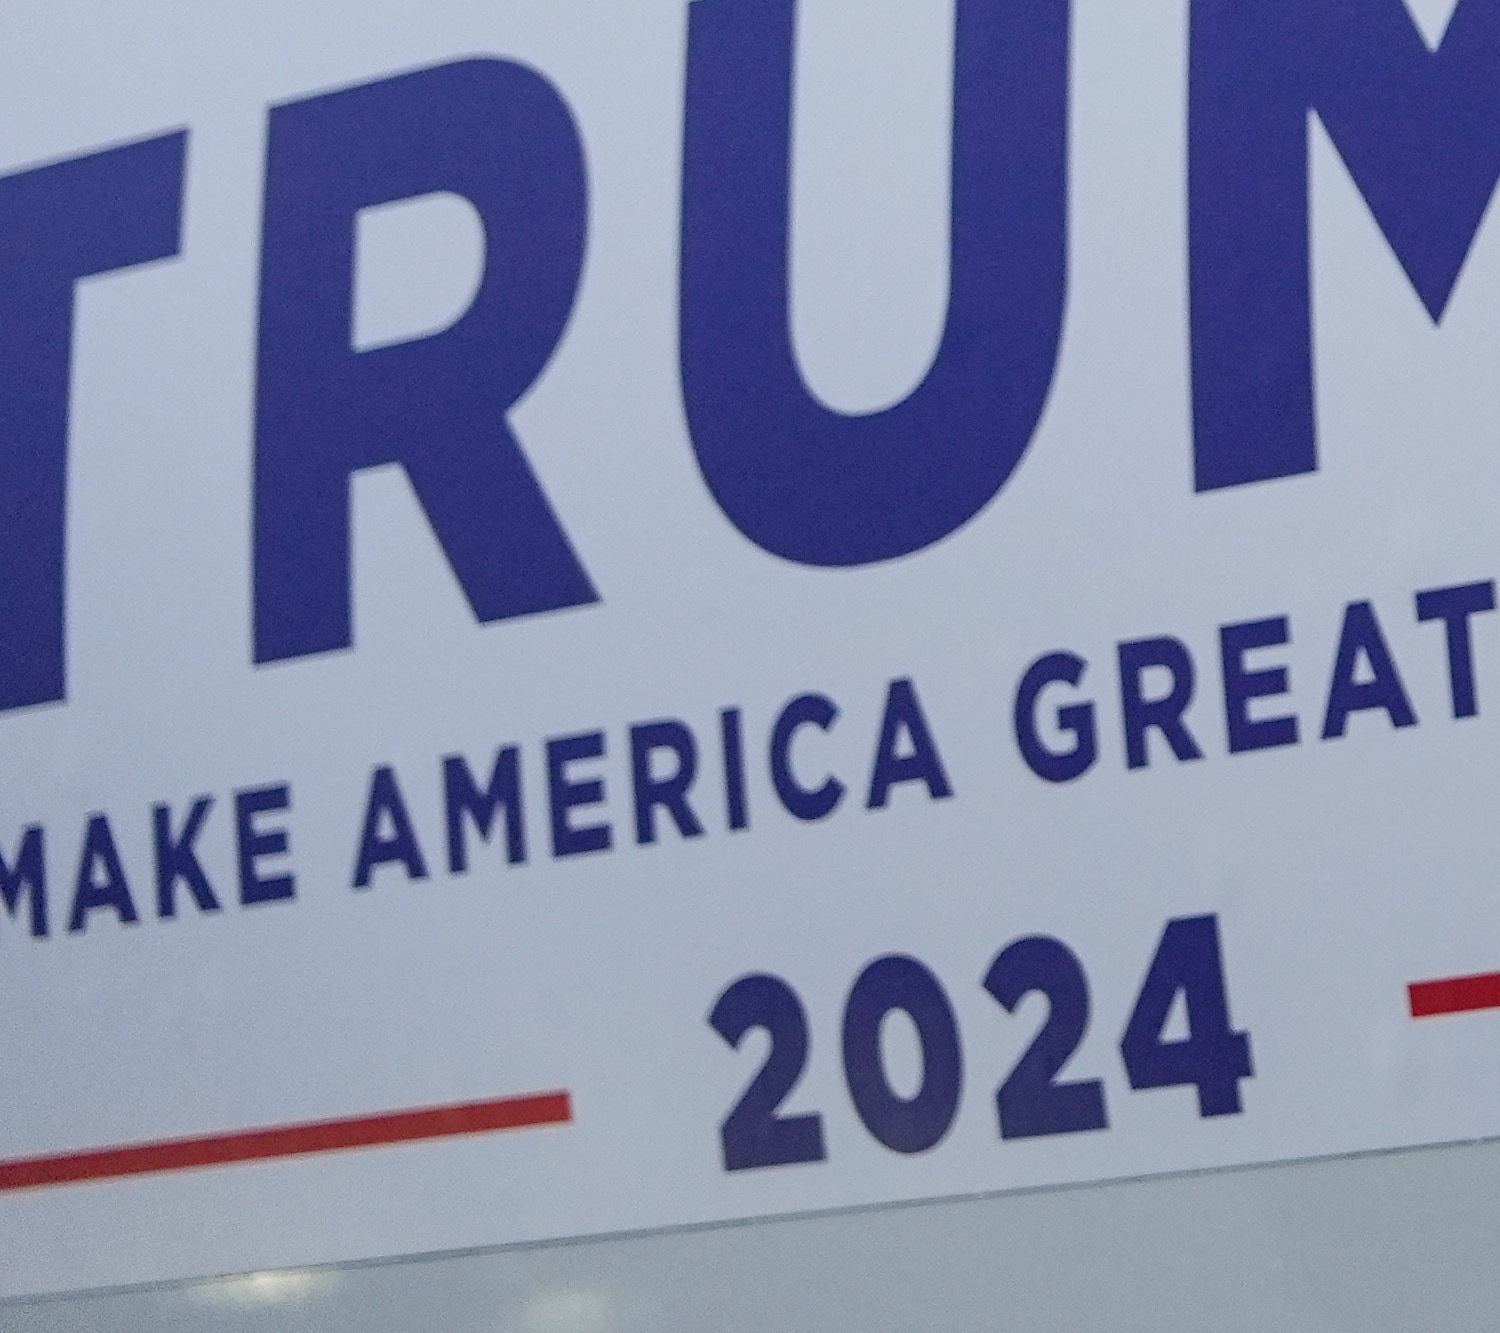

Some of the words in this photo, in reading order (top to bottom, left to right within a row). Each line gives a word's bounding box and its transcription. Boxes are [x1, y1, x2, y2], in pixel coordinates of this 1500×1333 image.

[350, 675, 955, 891] AMERICA
[1012, 578, 1499, 783] GREAT
[706, 911, 1255, 1173] 2024
